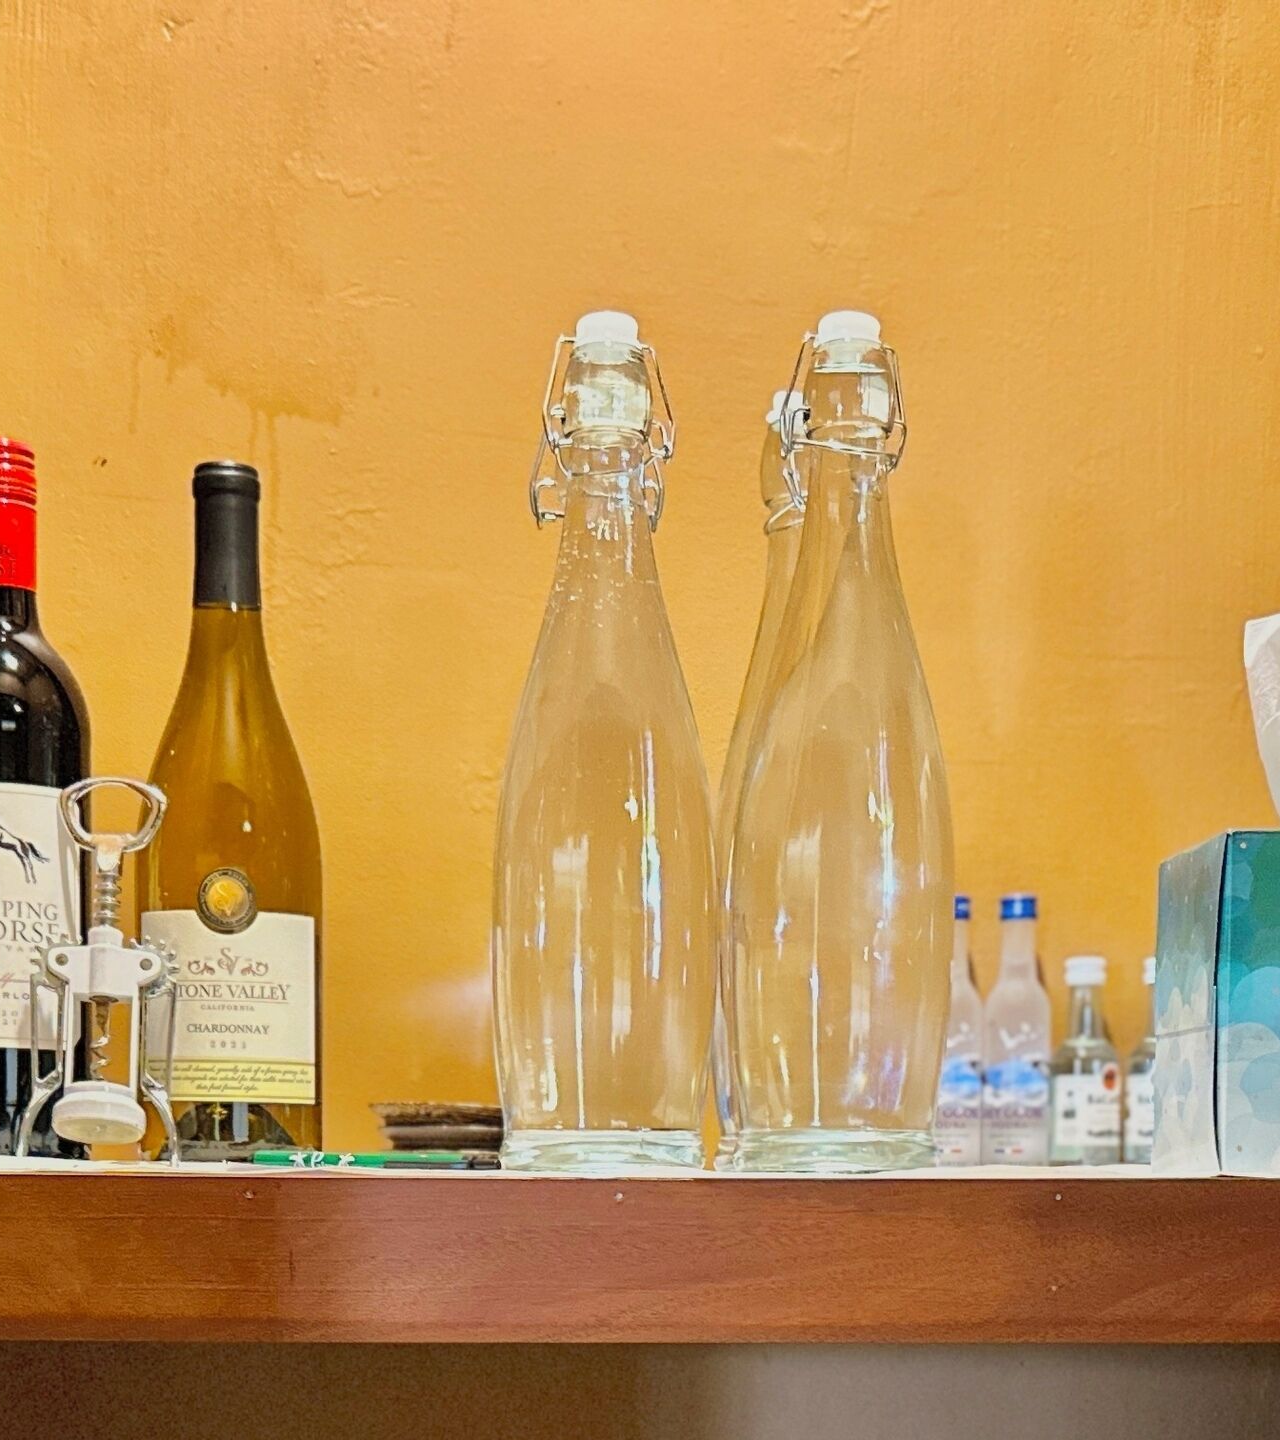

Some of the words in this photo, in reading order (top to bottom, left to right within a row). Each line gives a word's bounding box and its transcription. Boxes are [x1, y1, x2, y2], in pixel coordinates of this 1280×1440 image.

[177, 983, 223, 999] TONE
[227, 984, 290, 1001] VALLEY
[200, 1003, 255, 1012] CALIFORNIA
[186, 1023, 270, 1035] CHARDONNAY
